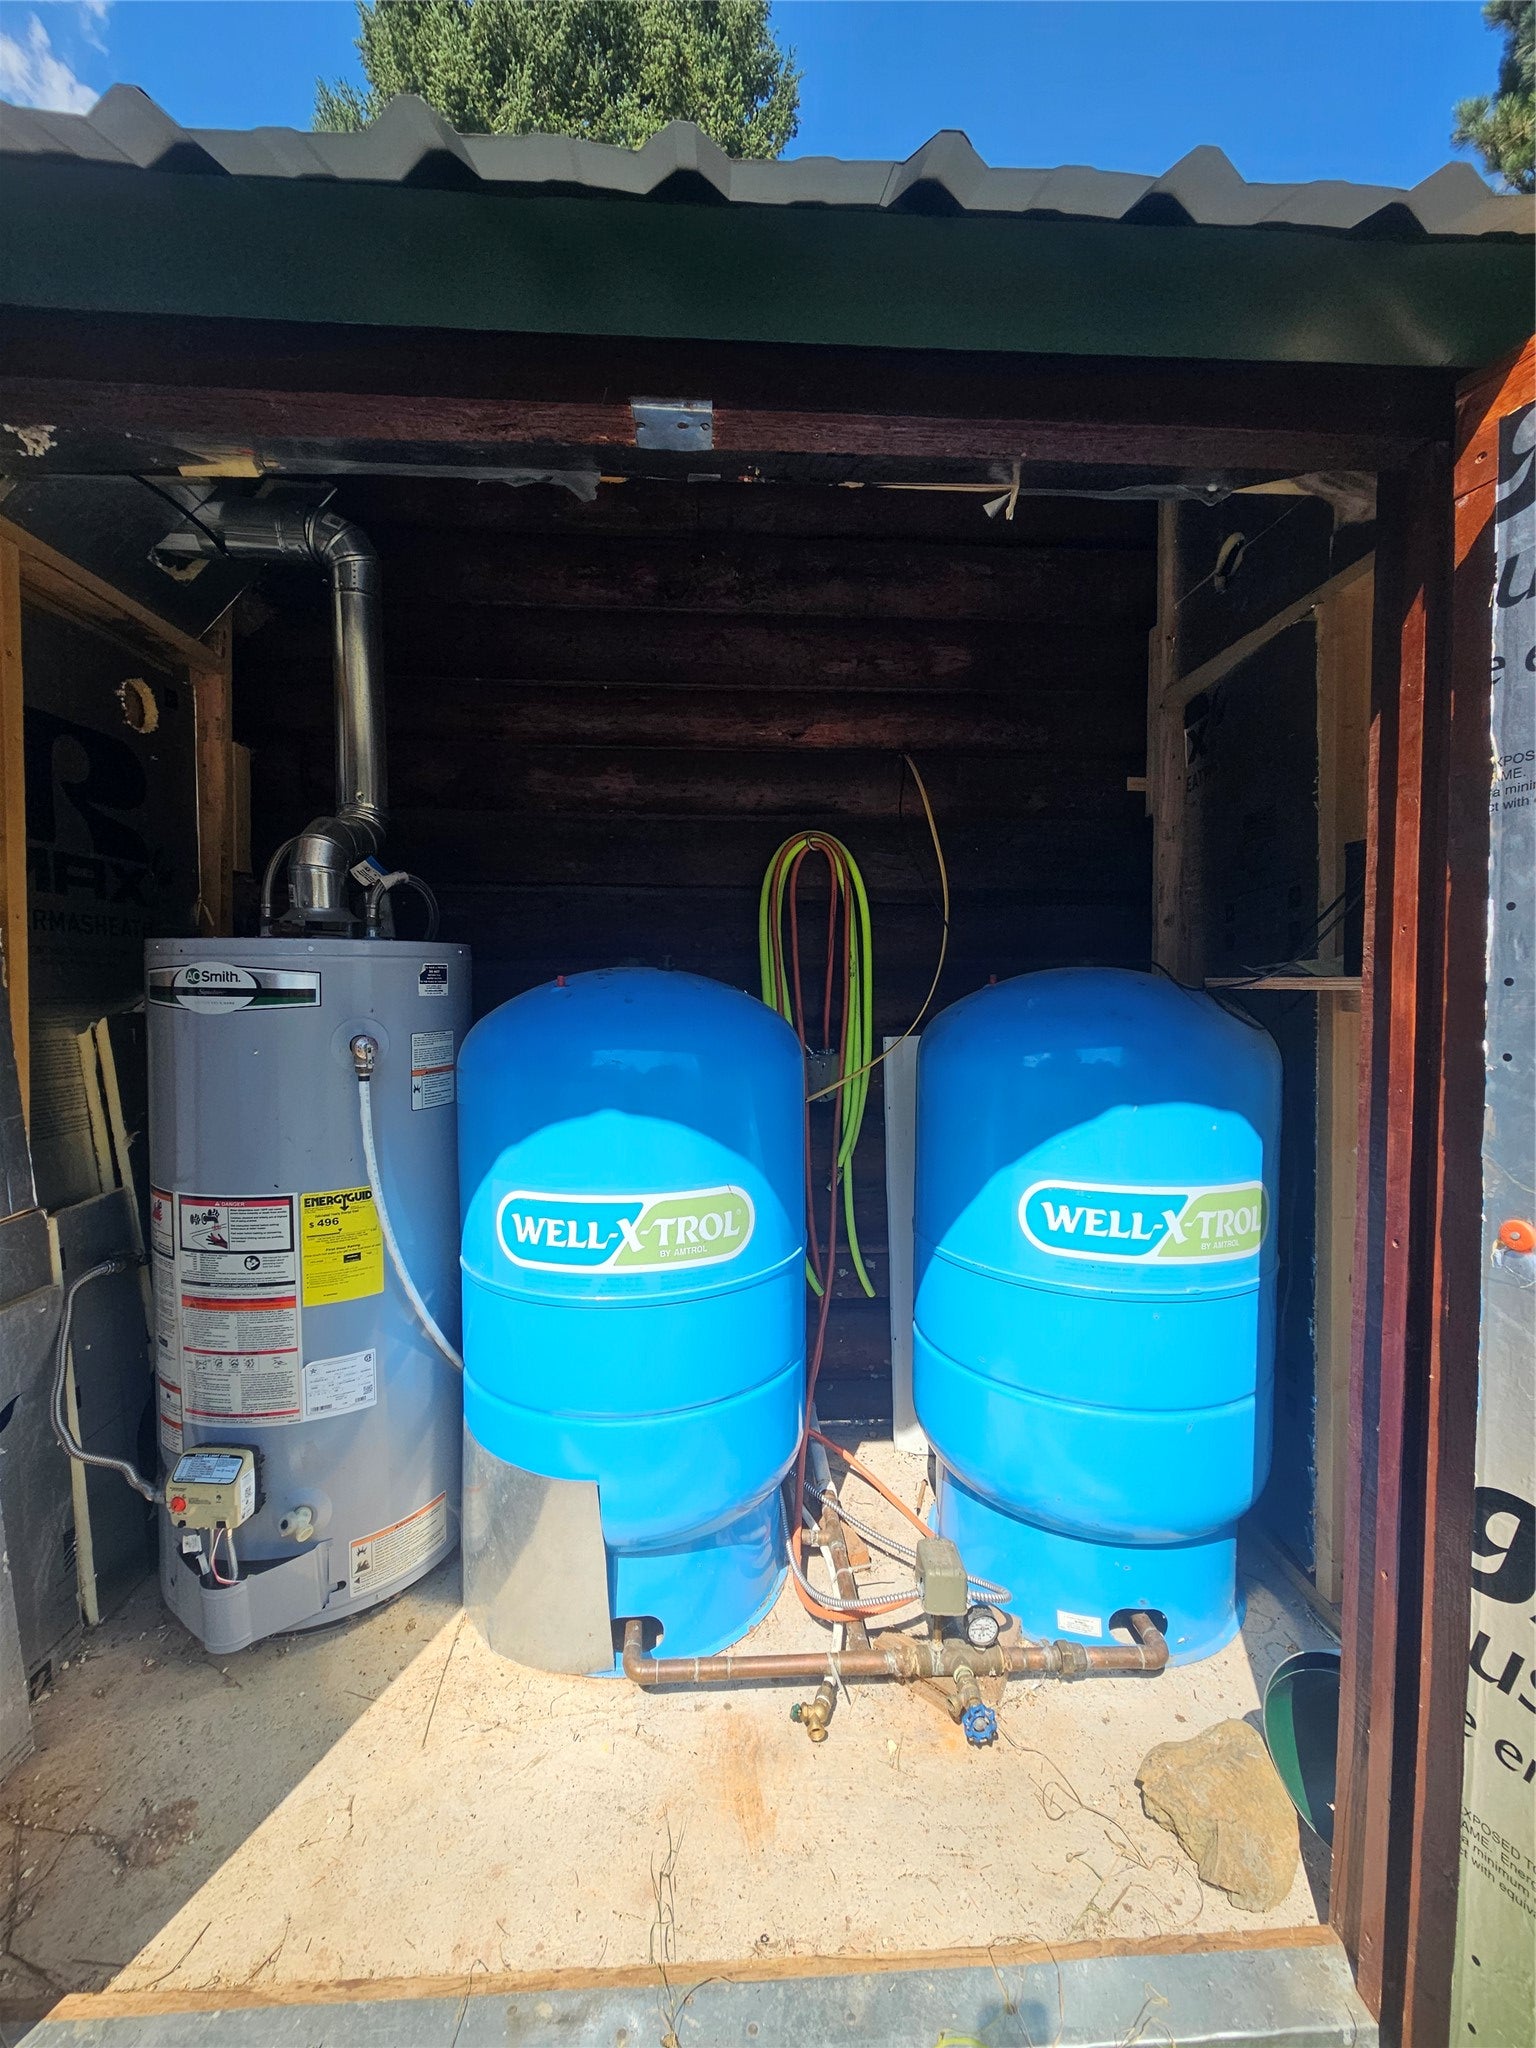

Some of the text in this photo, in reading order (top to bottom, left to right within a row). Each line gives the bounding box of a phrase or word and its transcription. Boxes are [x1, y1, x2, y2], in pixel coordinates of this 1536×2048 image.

[304, 1190, 372, 1209] ENERGYGUID
[317, 1217, 339, 1228] 496
[674, 1245, 707, 1256] AMTROL
[1471, 1856, 1495, 1883] with
[1472, 1845, 1530, 1898] minimum
